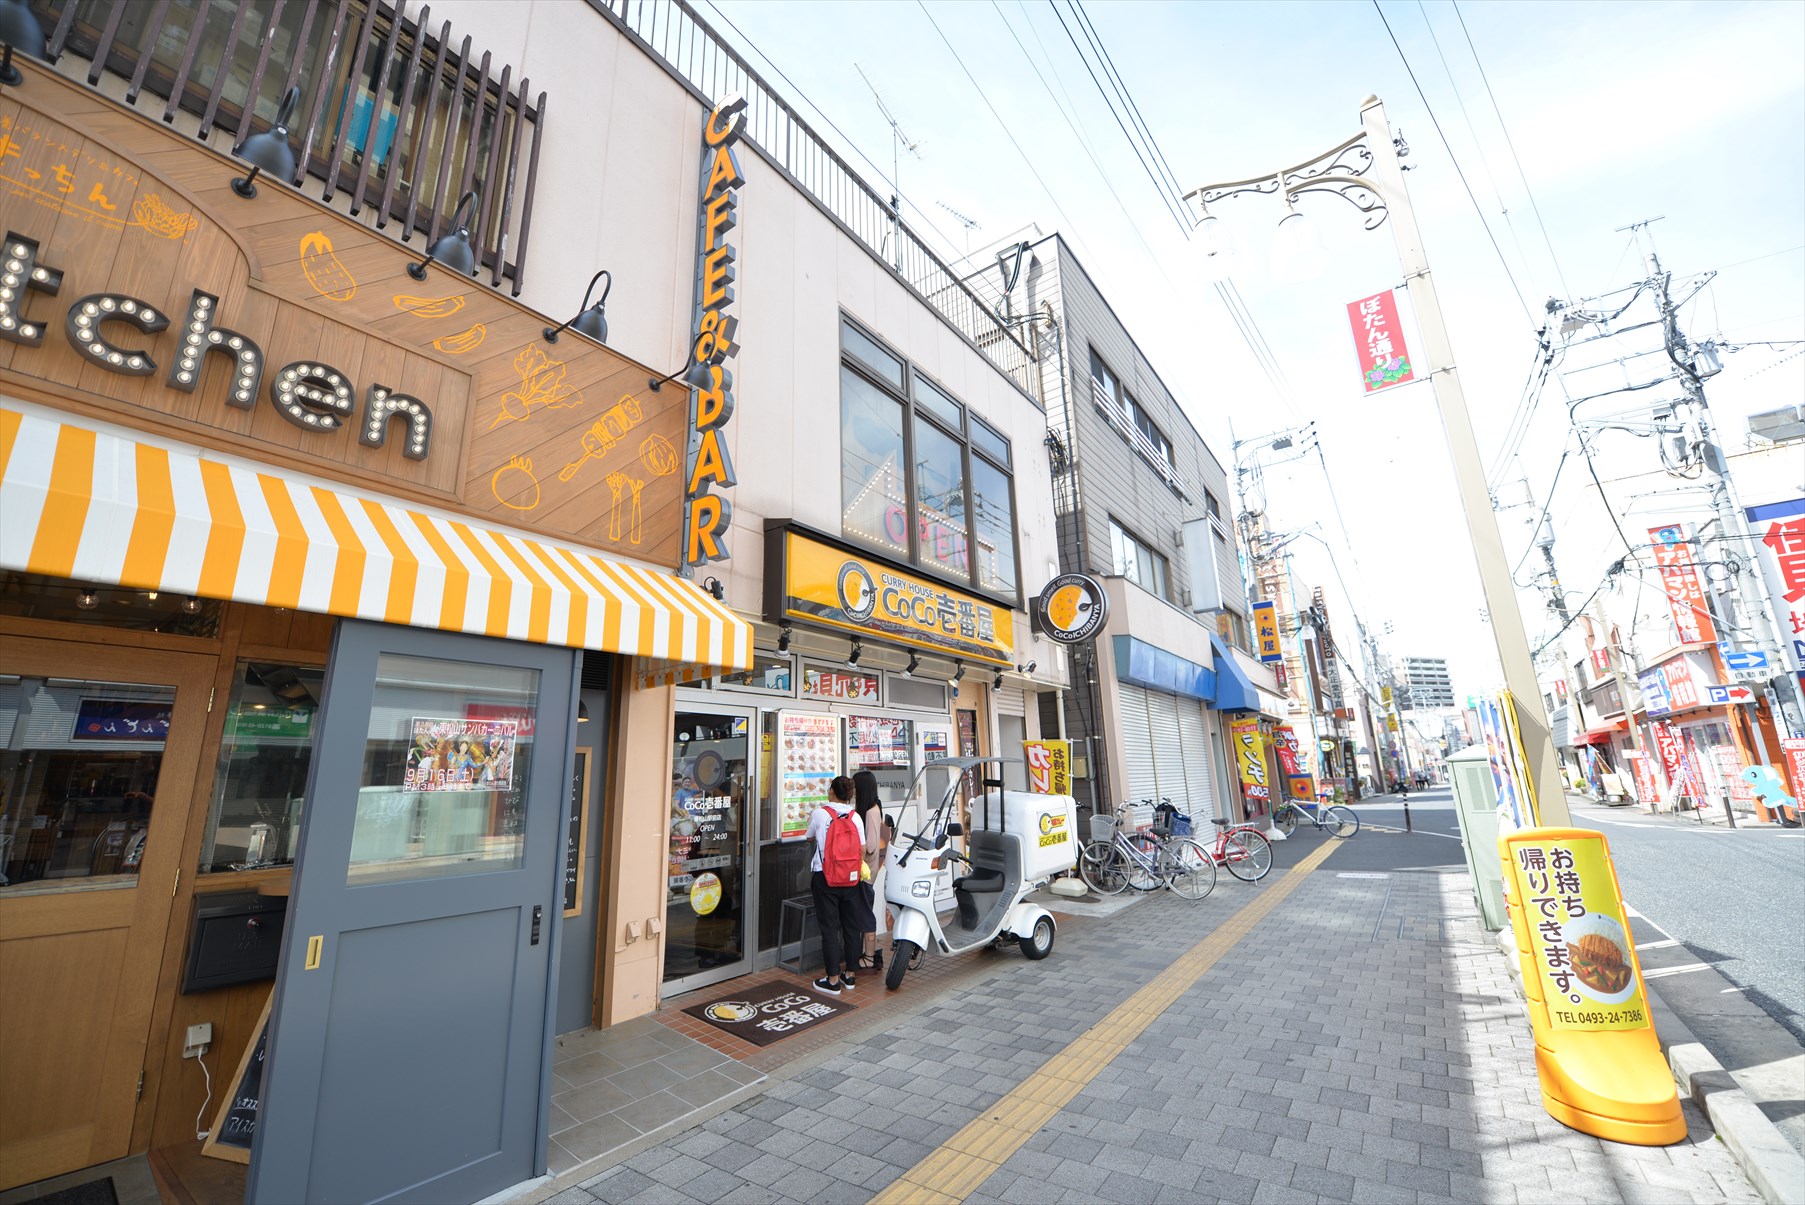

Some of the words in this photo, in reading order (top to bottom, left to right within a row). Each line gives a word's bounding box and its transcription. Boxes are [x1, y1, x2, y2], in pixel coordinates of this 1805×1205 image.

[702, 89, 748, 310] CAFE
[1360, 296, 1393, 369] ぼたん通り
[688, 363, 738, 568] BAR
[881, 573, 907, 590] CURRY
[908, 582, 934, 598] HOUSE
[882, 586, 995, 644] CoCo壱番屋
[1260, 626, 1275, 652] 松屋
[1711, 690, 1727, 702] P
[684, 796, 731, 811] CoCo壱番屋
[685, 835, 701, 844] 11:00
[712, 832, 728, 841] 24:00
[700, 824, 715, 833] OPEN
[1550, 847, 1586, 918] お持ち
[1508, 848, 1581, 1004] 帰りできます。
[756, 1002, 837, 1032] 壱番屋
[761, 995, 811, 1014] CoCo
[1556, 1011, 1578, 1024] TEL
[1578, 1010, 1643, 1025] 0493-24-7386
